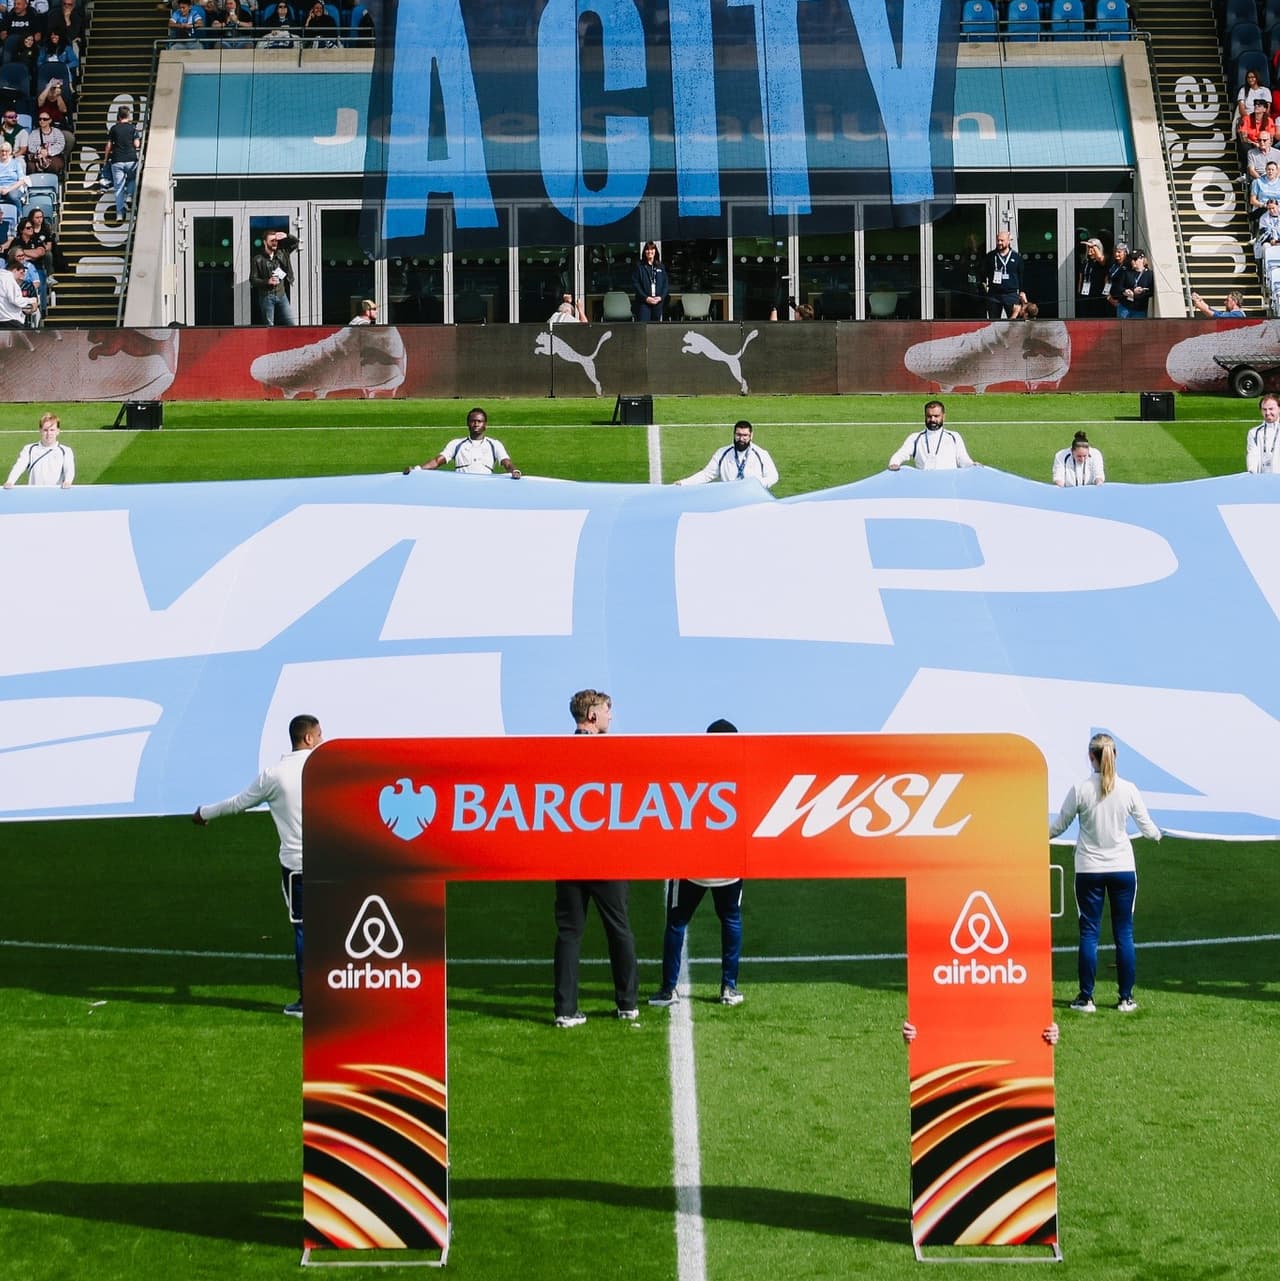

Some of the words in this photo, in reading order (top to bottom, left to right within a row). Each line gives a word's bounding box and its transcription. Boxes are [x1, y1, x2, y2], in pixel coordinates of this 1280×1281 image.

[451, 781, 737, 833] BARCLAYS
[752, 773, 972, 838] WSL
[327, 961, 422, 990] airbnb
[933, 958, 1027, 986] airbnb
